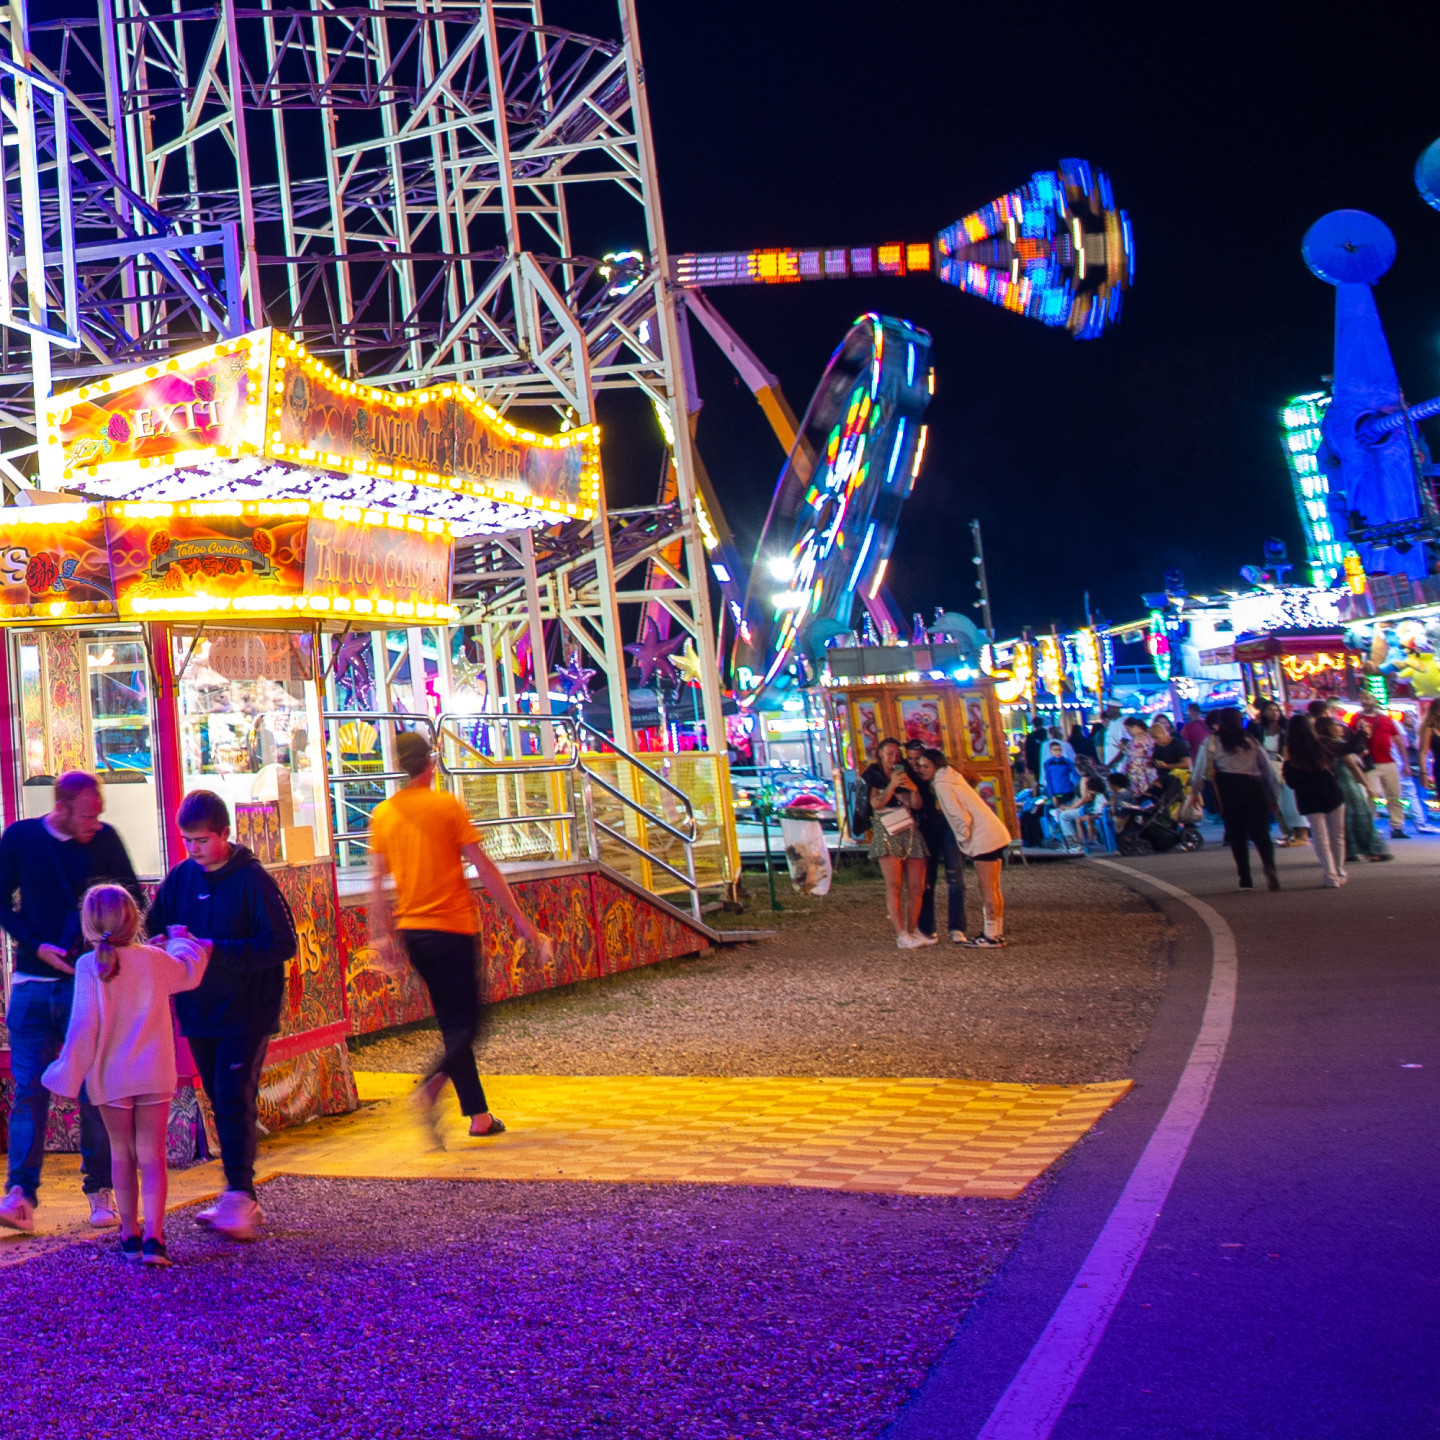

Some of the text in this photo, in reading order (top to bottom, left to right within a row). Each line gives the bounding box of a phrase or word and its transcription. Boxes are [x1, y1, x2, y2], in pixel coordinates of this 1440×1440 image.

[131, 399, 223, 439] EXIT
[174, 542, 249, 558] Tattoo Coaster
